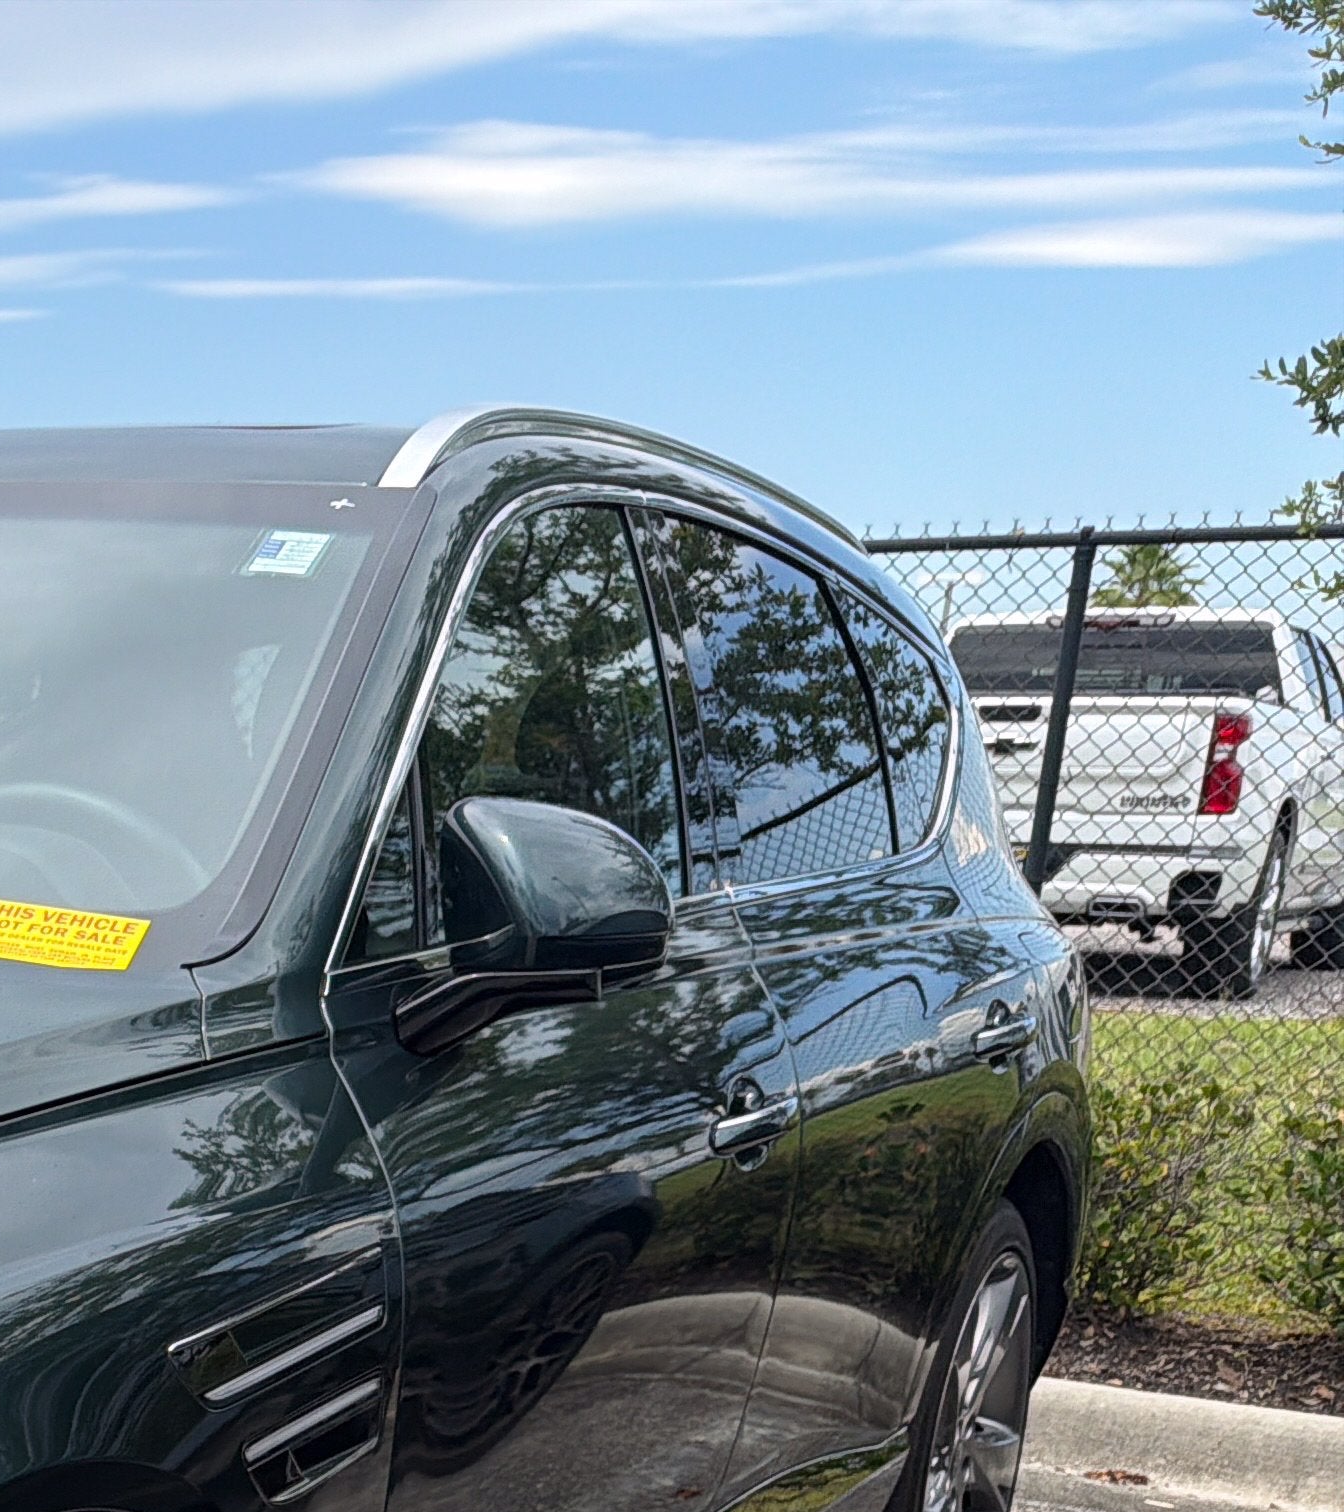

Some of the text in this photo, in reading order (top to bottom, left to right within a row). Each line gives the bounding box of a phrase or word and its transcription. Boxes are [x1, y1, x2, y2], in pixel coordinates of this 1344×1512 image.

[41, 909, 140, 935] VEHICLE
[26, 923, 70, 937] FOR
[72, 930, 127, 946] SALE
